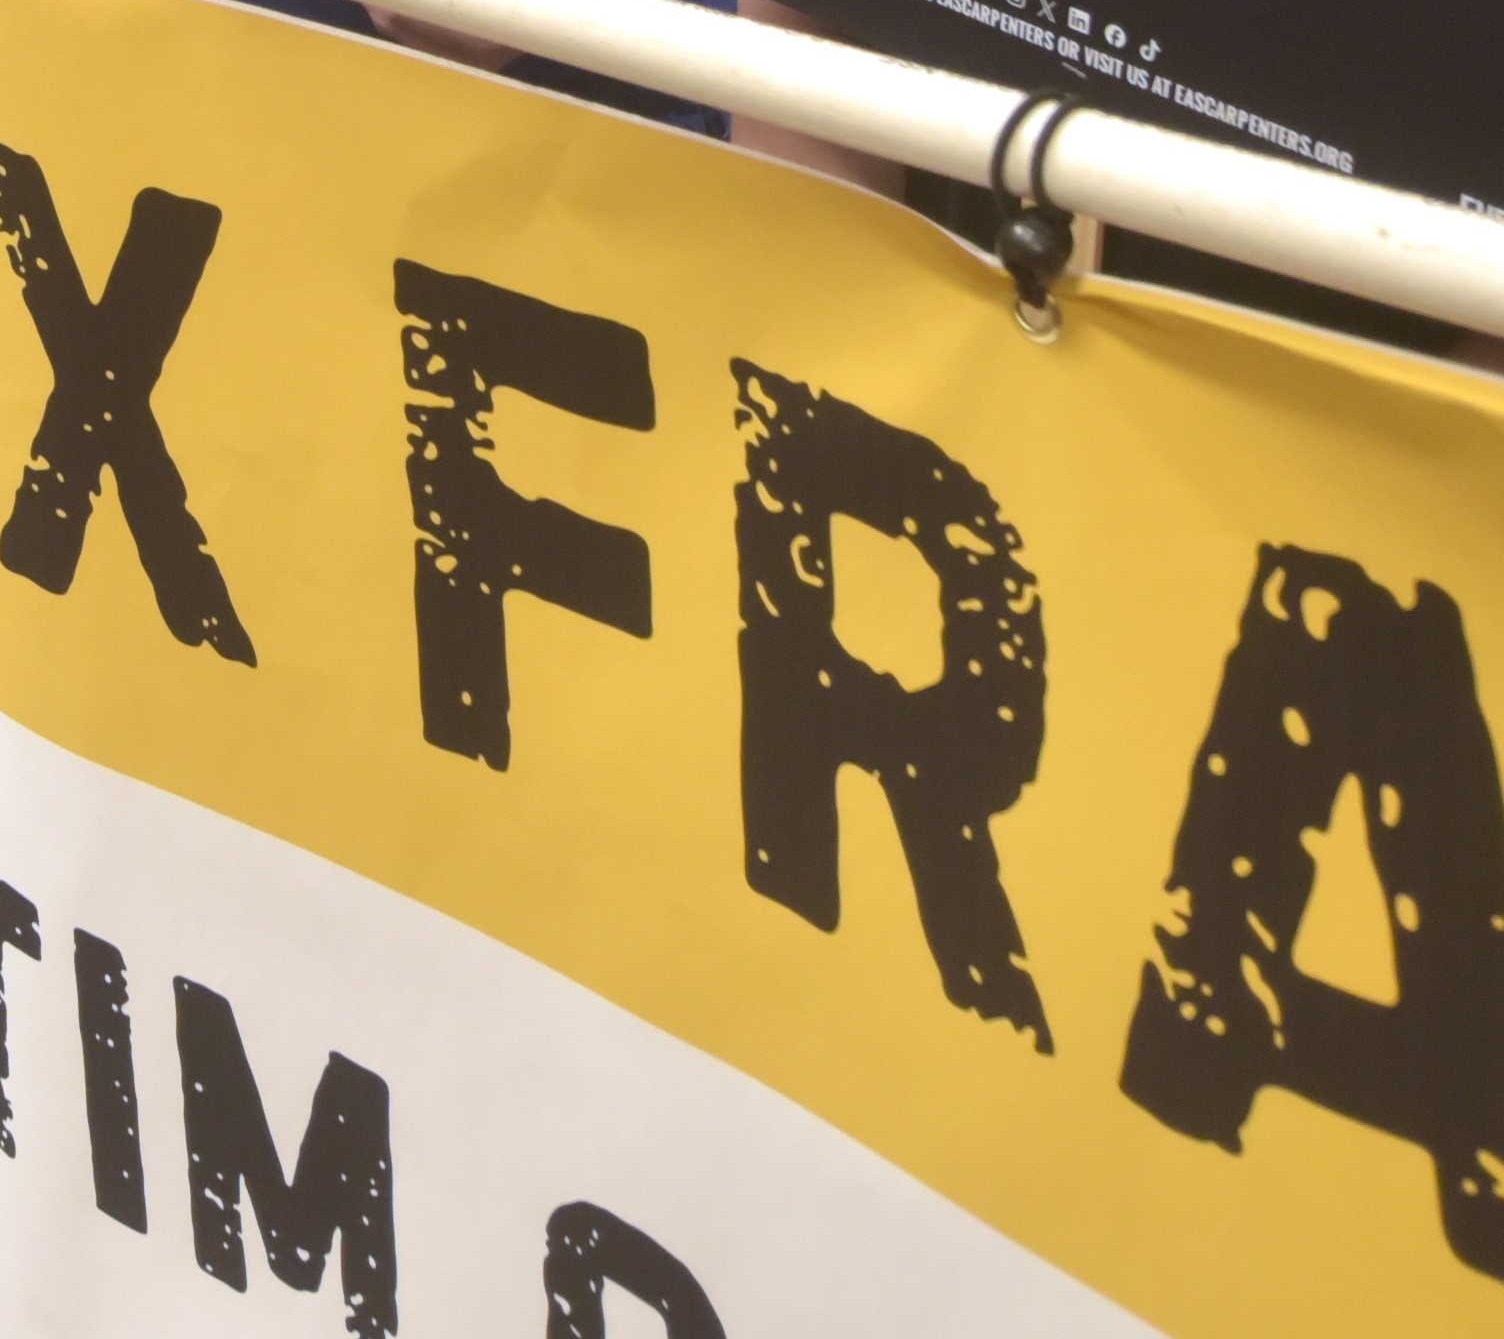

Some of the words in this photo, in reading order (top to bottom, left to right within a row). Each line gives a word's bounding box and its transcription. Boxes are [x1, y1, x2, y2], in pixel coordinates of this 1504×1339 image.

[1057, 34, 1080, 61] OR
[1084, 45, 1125, 80] VISIT
[1126, 63, 1149, 91] US
[1151, 75, 1172, 100] AT
[1174, 84, 1353, 174] EASCARPENTERS.ORG
